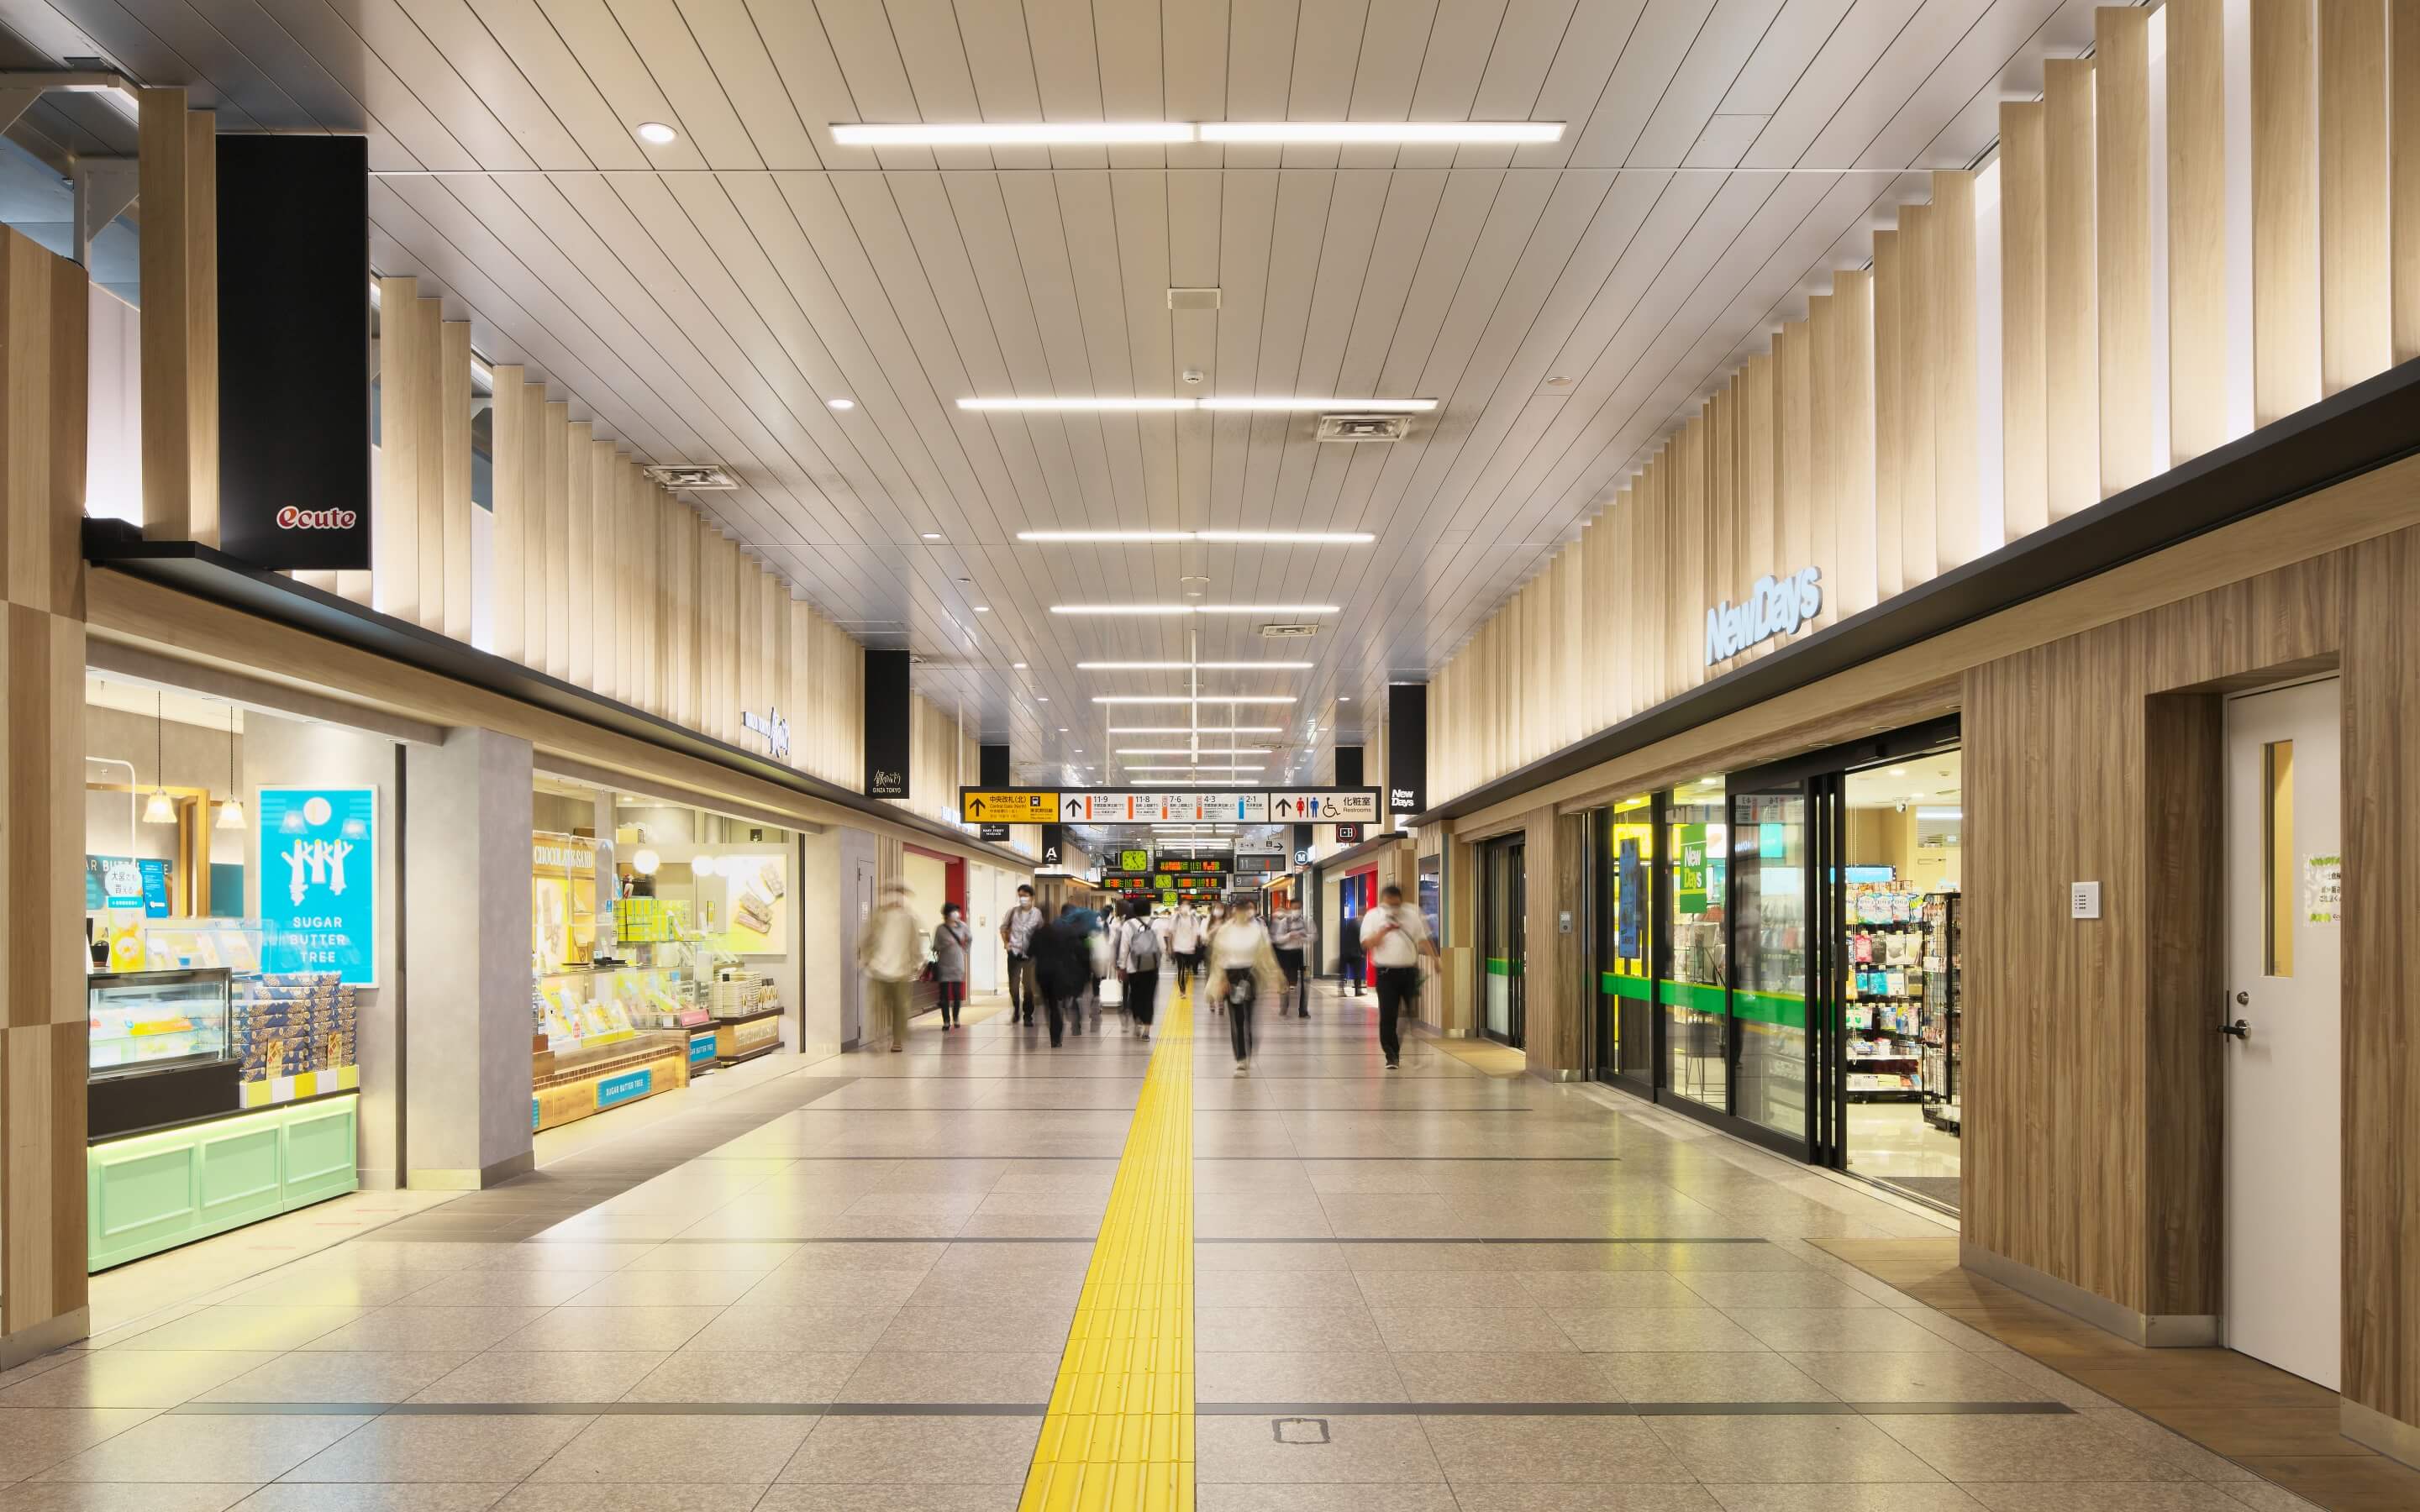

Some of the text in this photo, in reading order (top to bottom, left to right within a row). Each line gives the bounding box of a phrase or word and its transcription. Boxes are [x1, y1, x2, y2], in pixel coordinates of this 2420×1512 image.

[276, 506, 356, 530] ecute
[1706, 566, 1823, 666] NewDays
[1392, 789, 1413, 799] New
[1343, 796, 1371, 806] 化粧室
[1392, 797, 1414, 807] Days
[1684, 846, 1702, 867] New
[1684, 868, 1702, 889] Days
[292, 916, 343, 928] SUGAR
[290, 934, 346, 946] BUTTER
[300, 951, 336, 963] TREE
